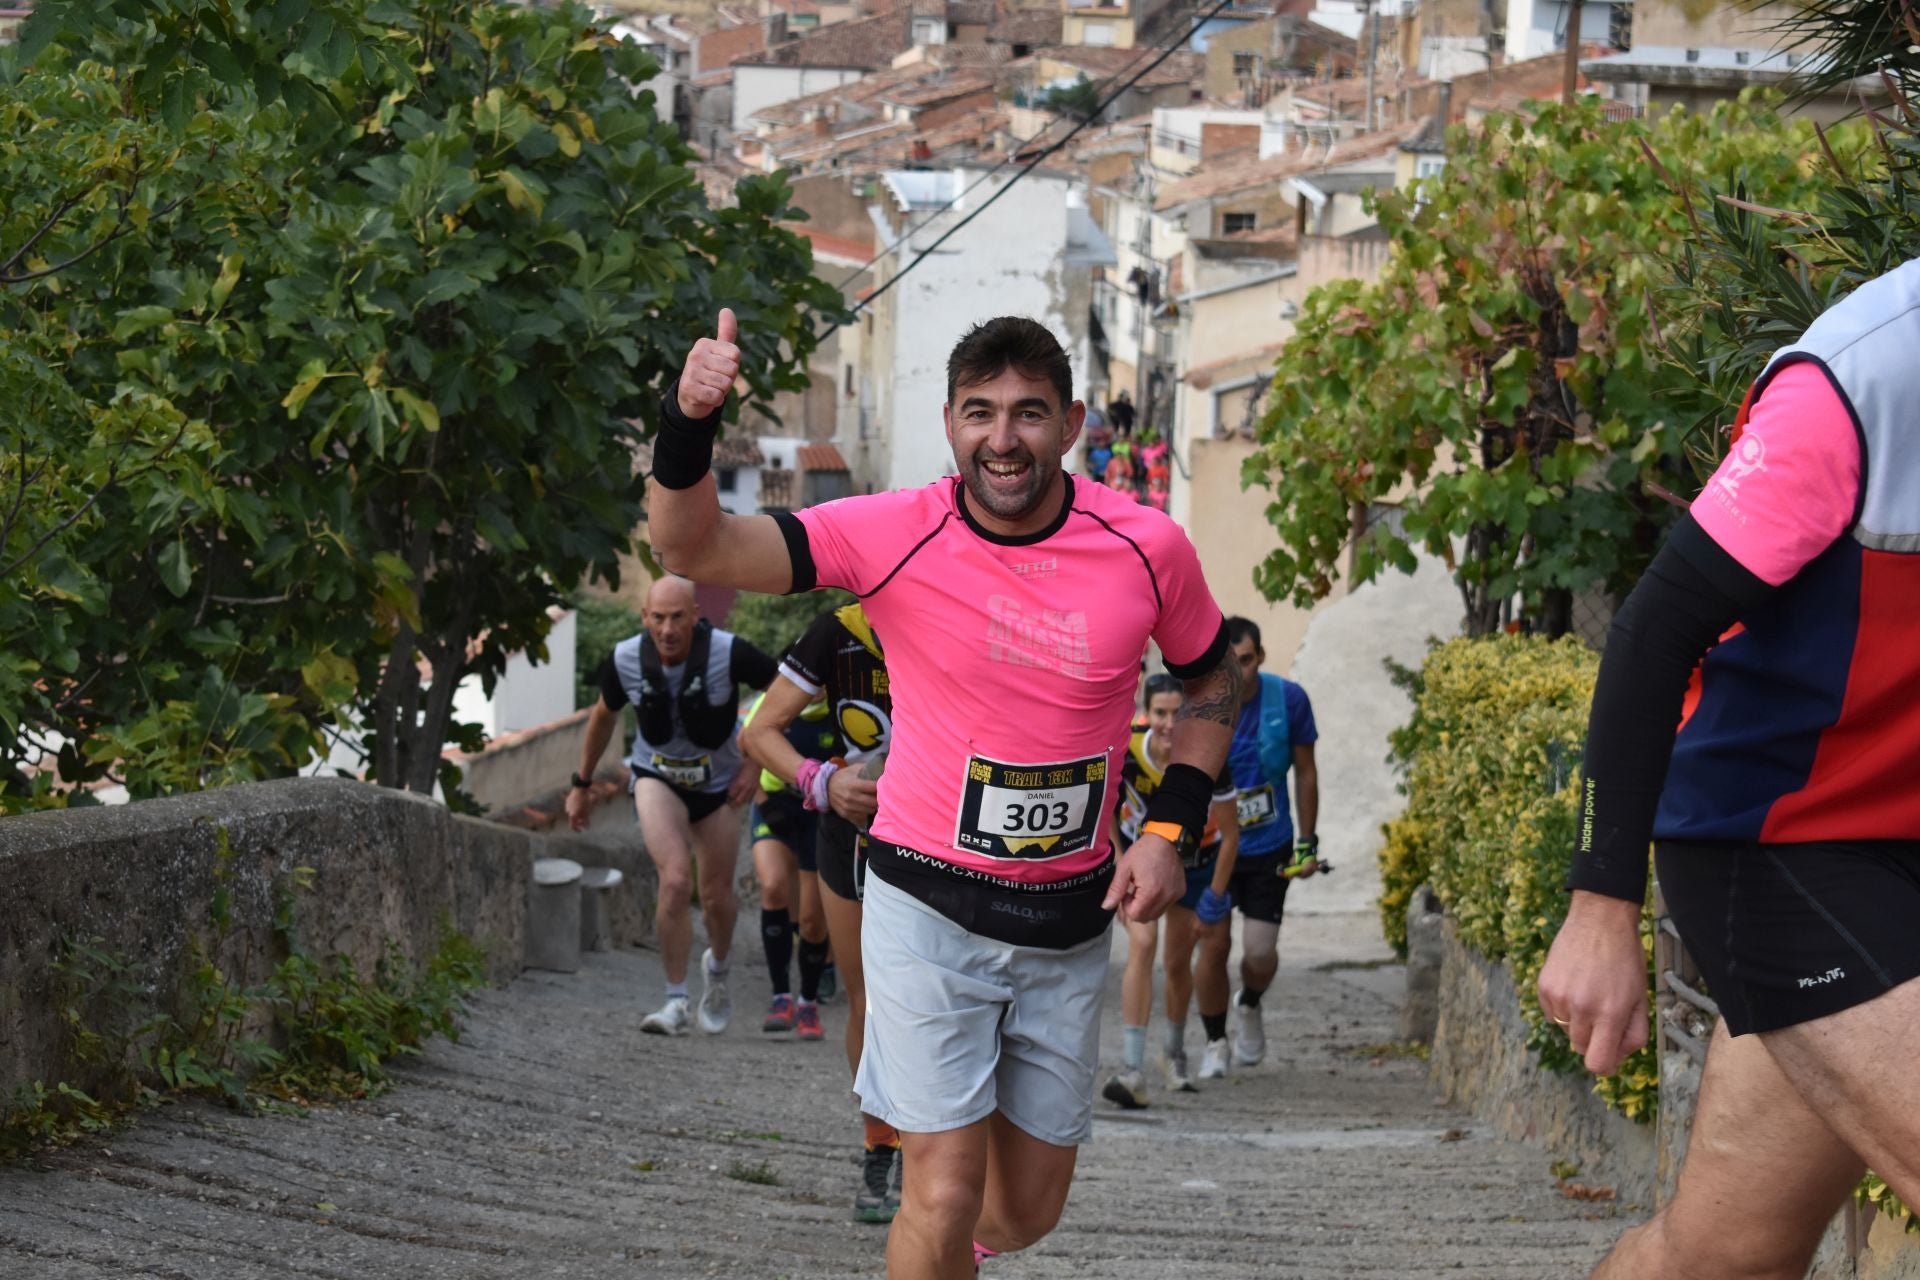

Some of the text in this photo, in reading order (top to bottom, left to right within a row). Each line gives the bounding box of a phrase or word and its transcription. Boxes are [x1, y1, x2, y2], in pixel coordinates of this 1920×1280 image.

[1003, 768, 1074, 787] TRAIL 13K
[1027, 792, 1055, 800] DANIEL
[1002, 801, 1070, 832] 303
[1580, 777, 1597, 852] hidden power
